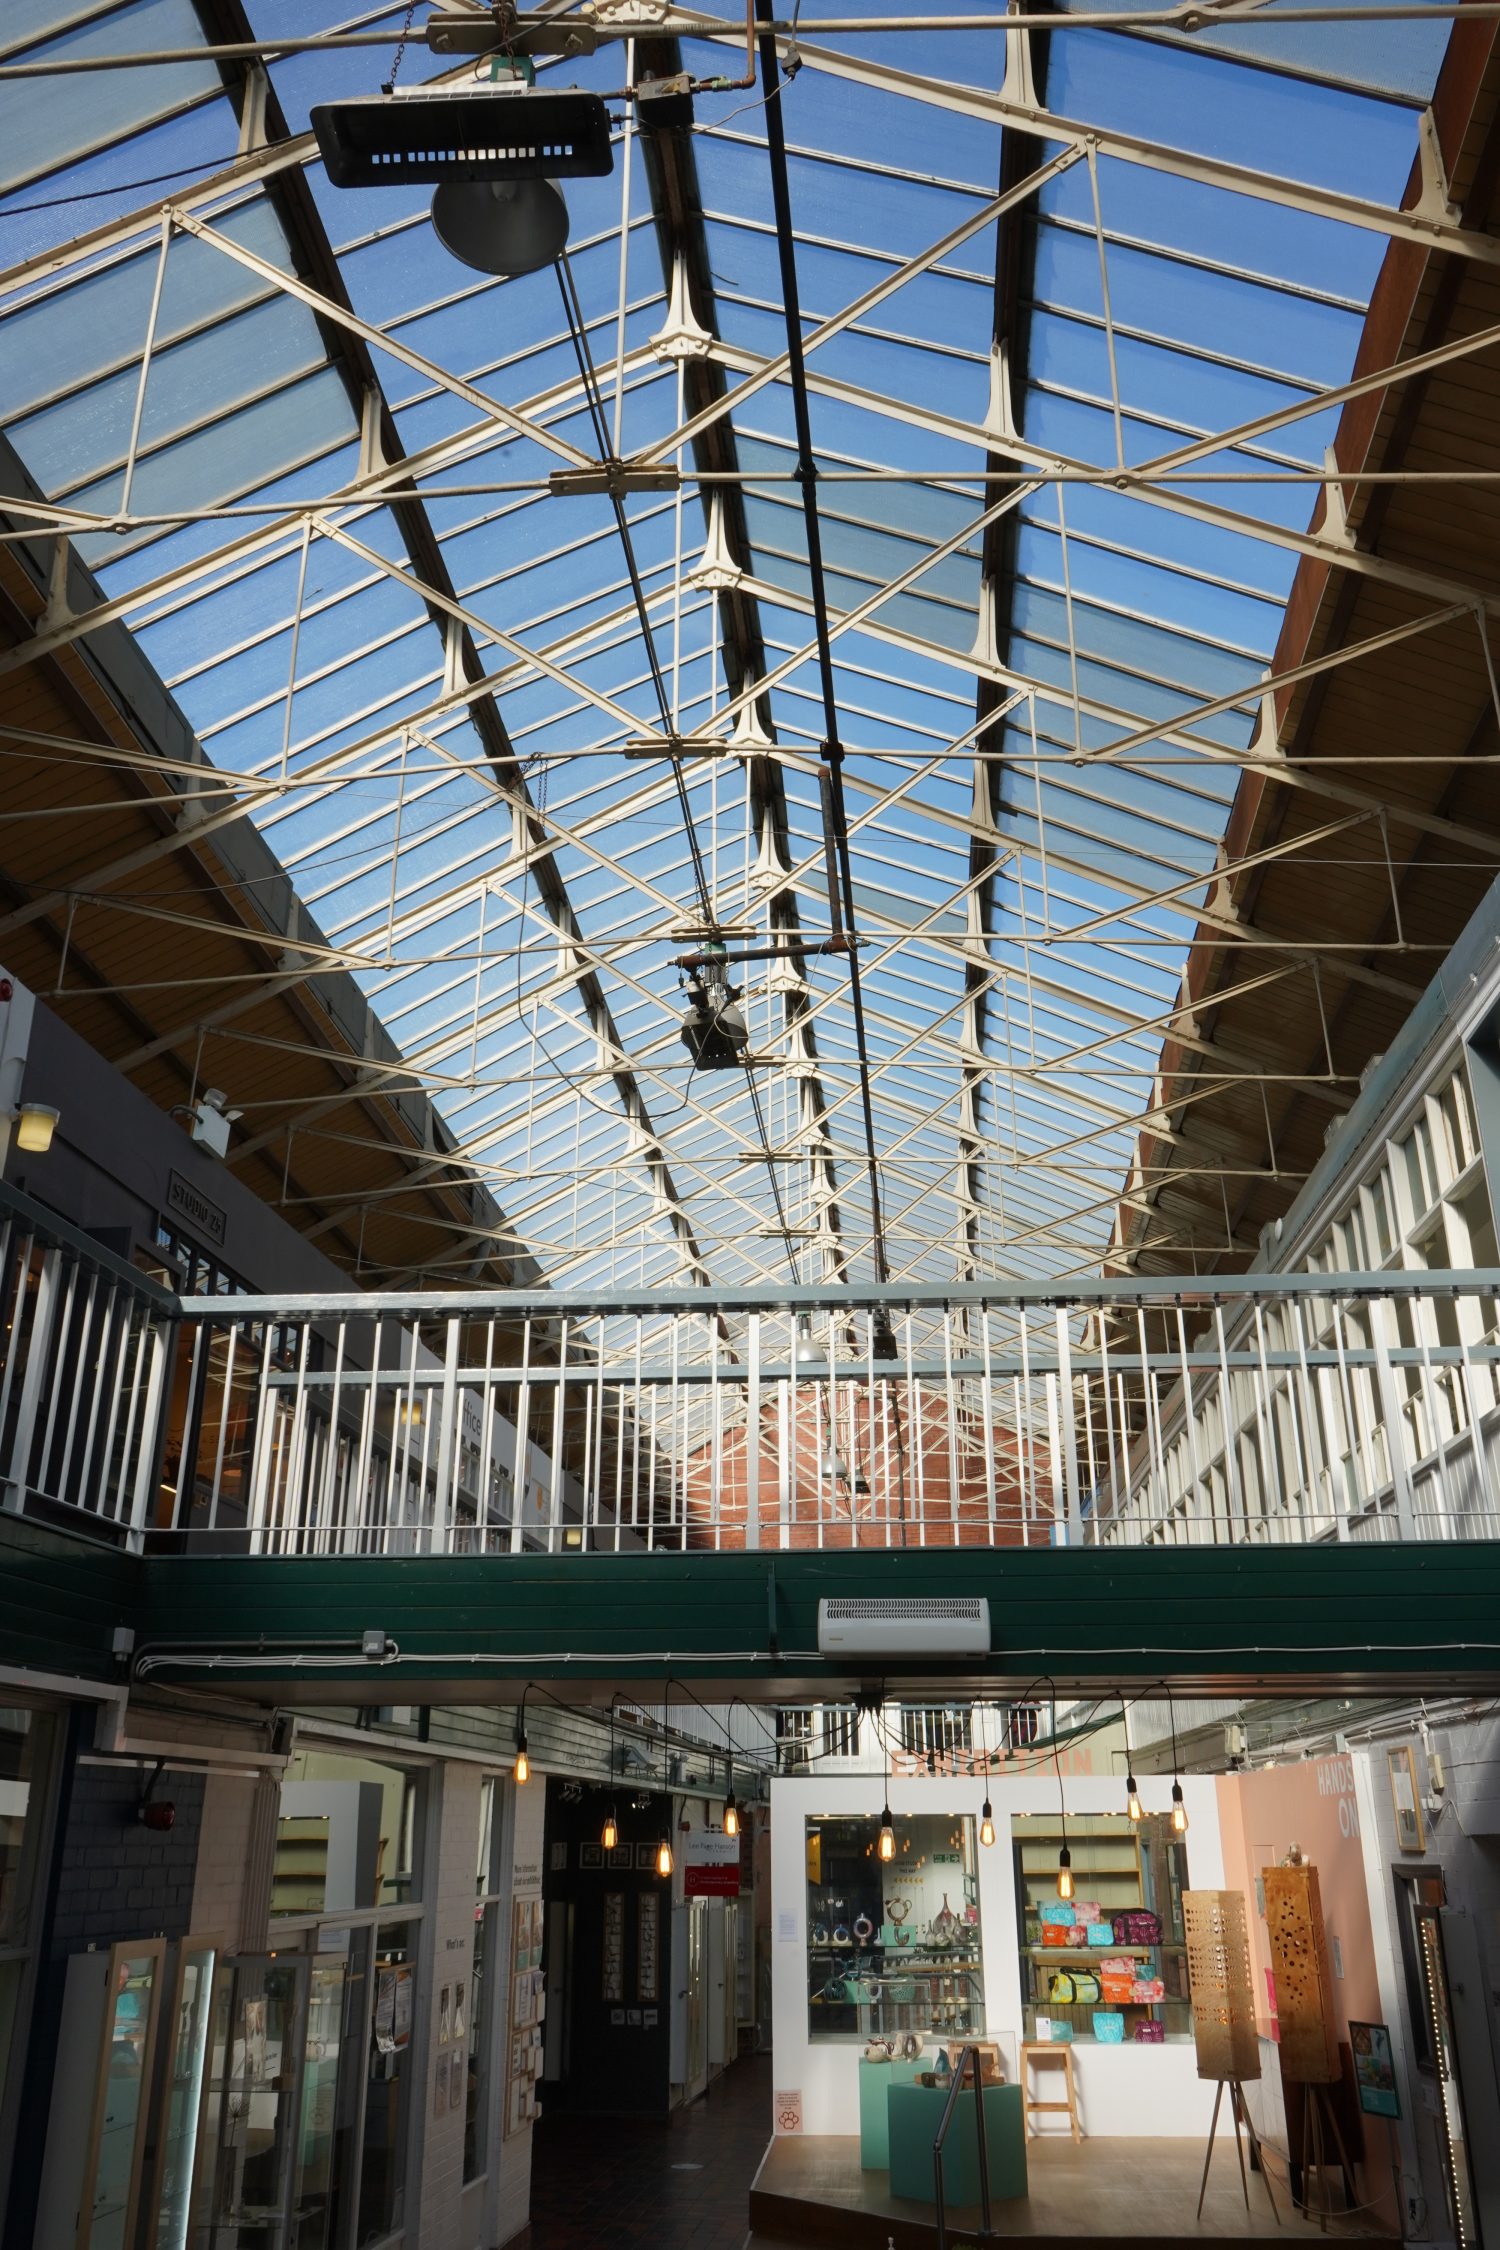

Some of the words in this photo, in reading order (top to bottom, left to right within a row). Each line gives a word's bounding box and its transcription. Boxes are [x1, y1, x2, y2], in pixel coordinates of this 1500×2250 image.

[172, 1183, 209, 1223] STUDIO
[1317, 1759, 1355, 1795] HANDS
[1338, 1797, 1361, 1838] ON
